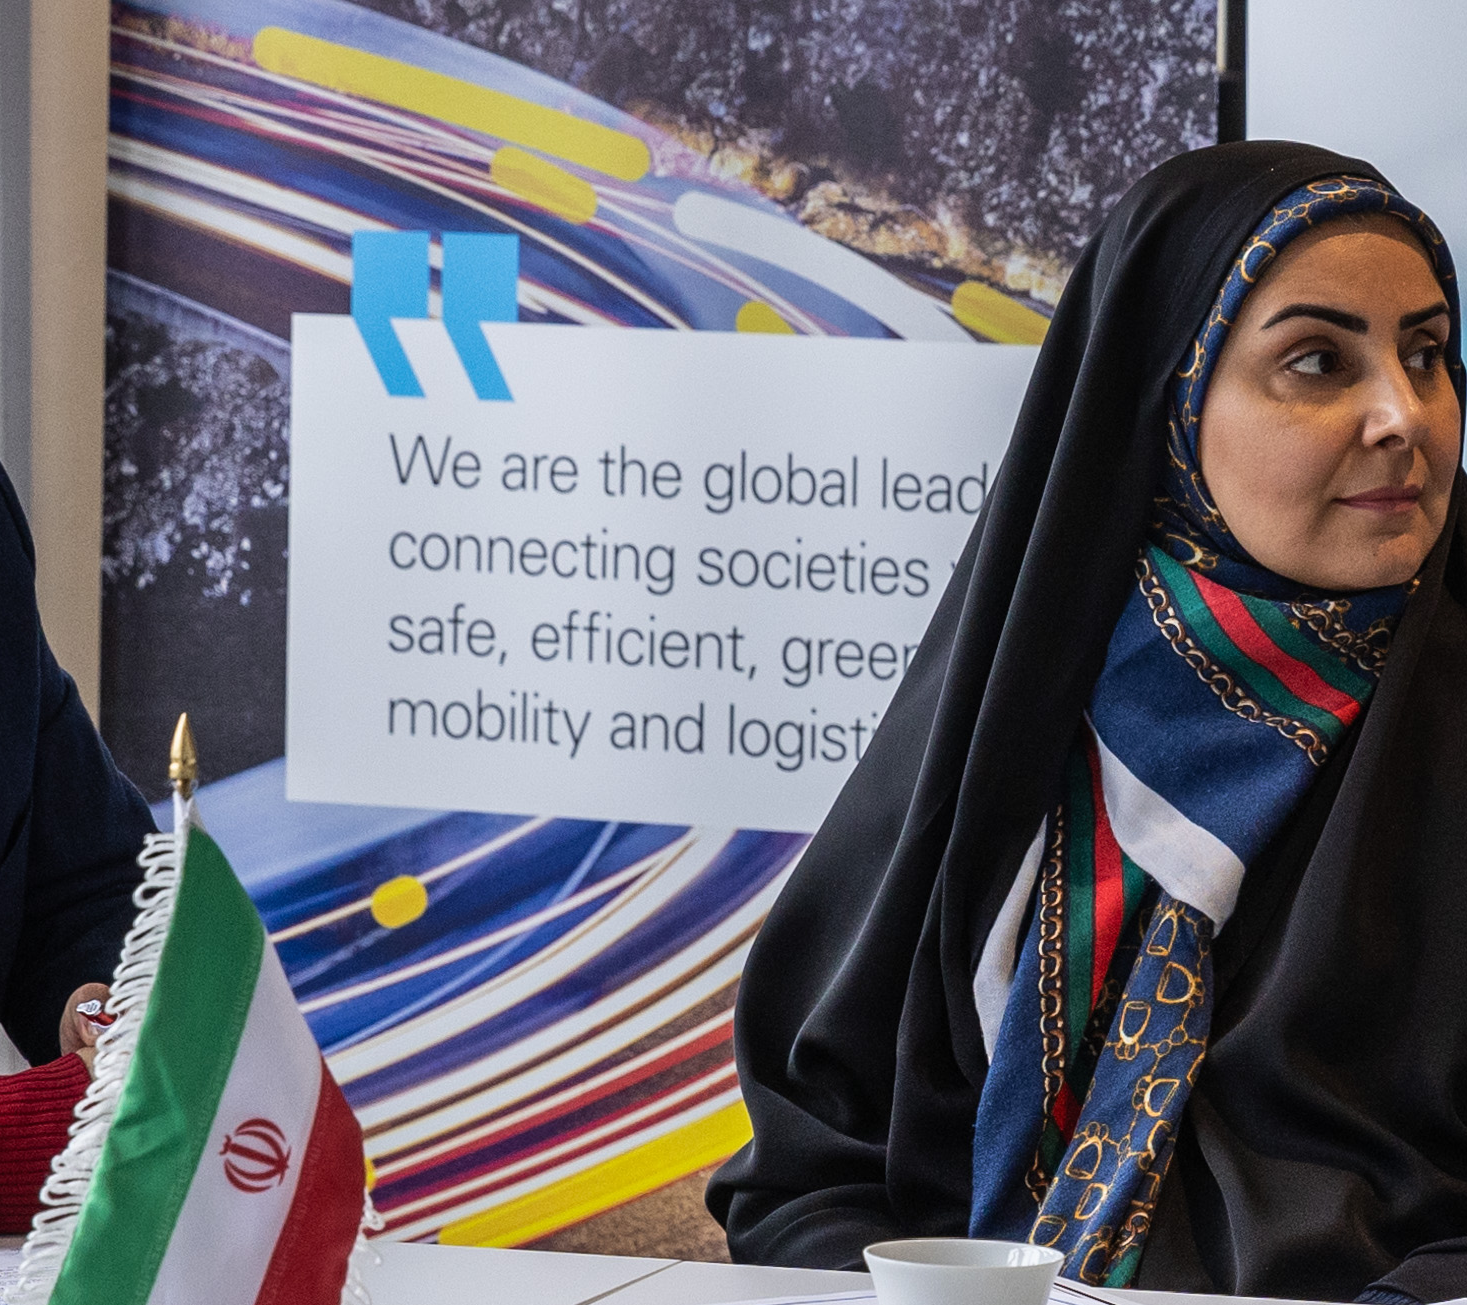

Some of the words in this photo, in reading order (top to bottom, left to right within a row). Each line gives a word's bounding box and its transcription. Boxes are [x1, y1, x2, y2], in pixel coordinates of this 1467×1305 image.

[389, 432, 482, 490] We
[501, 451, 579, 494] are
[599, 444, 683, 499] the
[704, 449, 860, 514] global
[881, 457, 988, 515] lead
[389, 528, 675, 595] connecting
[697, 537, 931, 597] societies
[388, 603, 508, 666] safe,
[531, 610, 758, 681] efficient,
[387, 689, 592, 760] mobility
[609, 703, 705, 755] and
